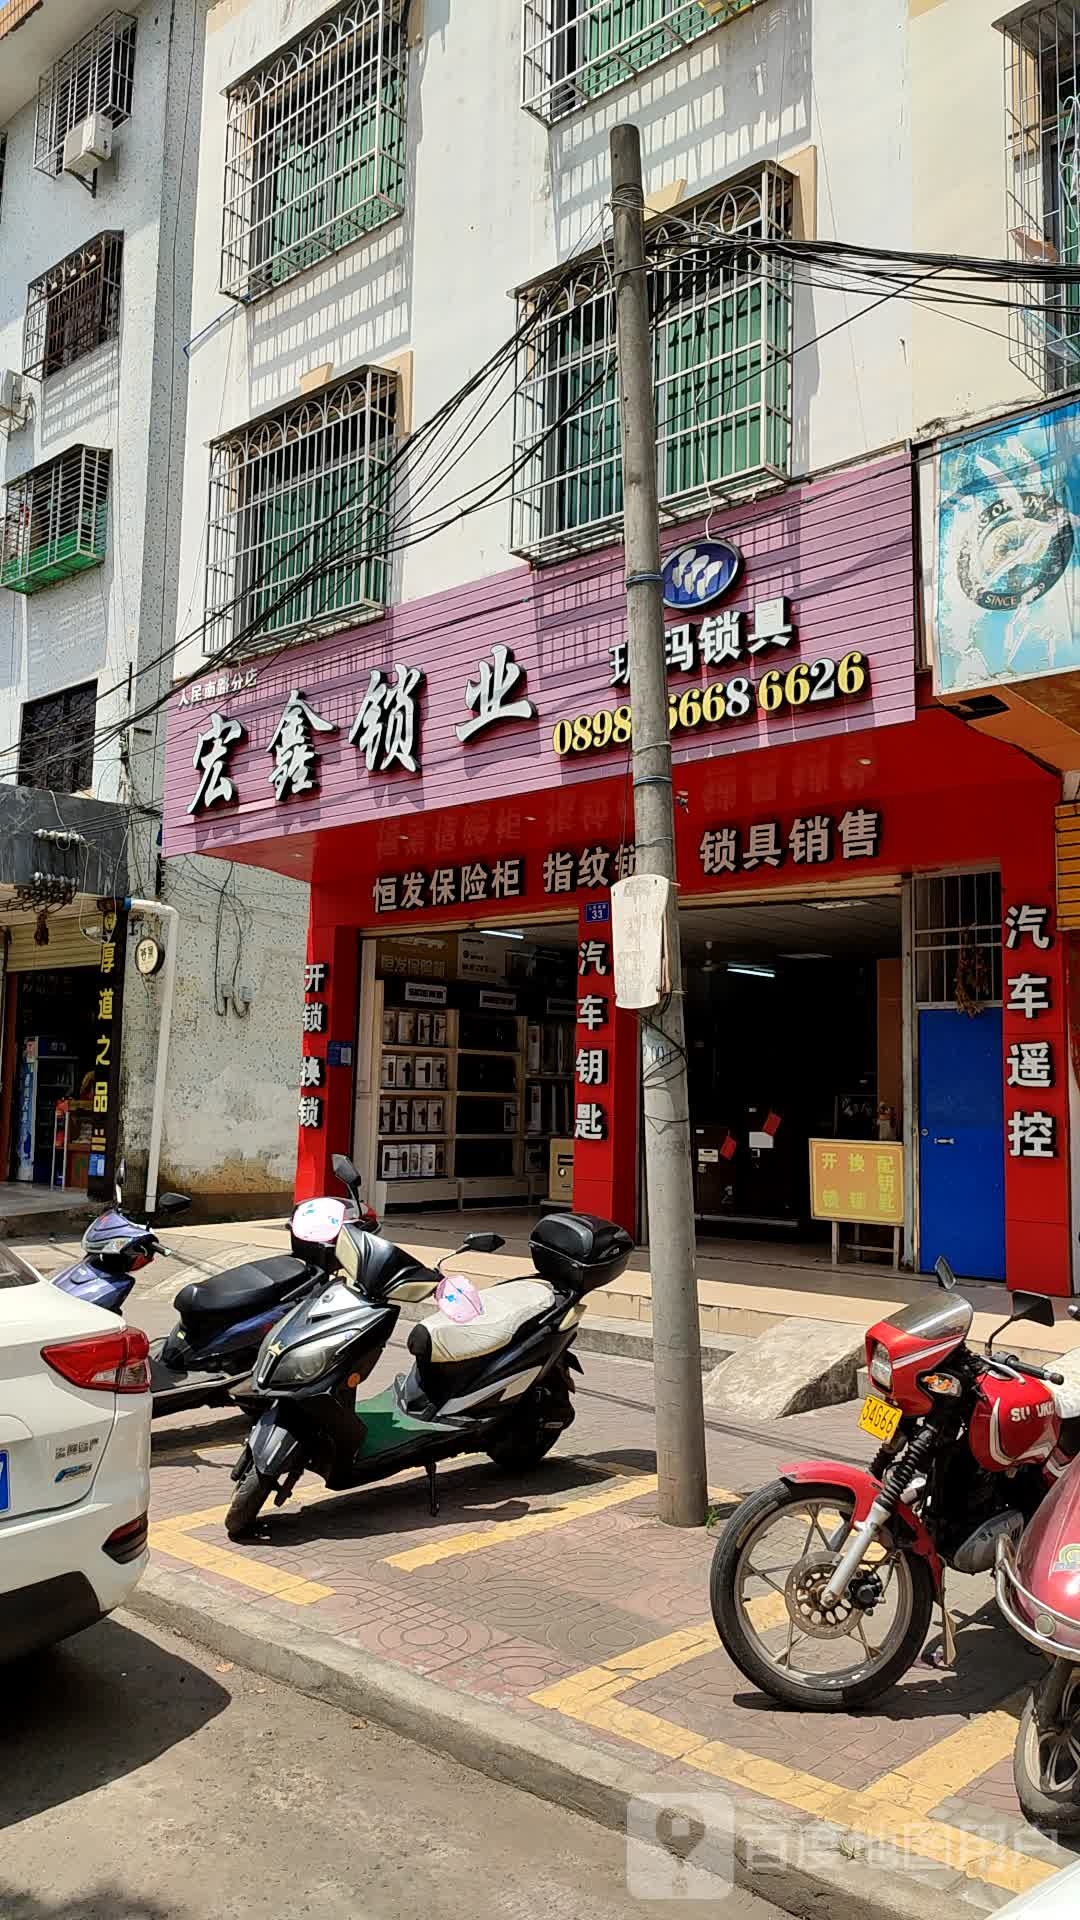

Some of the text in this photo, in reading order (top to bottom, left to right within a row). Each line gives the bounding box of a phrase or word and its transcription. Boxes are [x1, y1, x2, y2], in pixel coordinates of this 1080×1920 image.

[178, 667, 257, 707] 人民南路分店
[187, 644, 534, 815] 宏鑫锁业
[373, 859, 521, 914] 恒发保险柜
[700, 808, 879, 875] 锁具销售
[574, 940, 608, 1140] 汽车钥匙
[1005, 905, 1055, 1158] 汽车遥控
